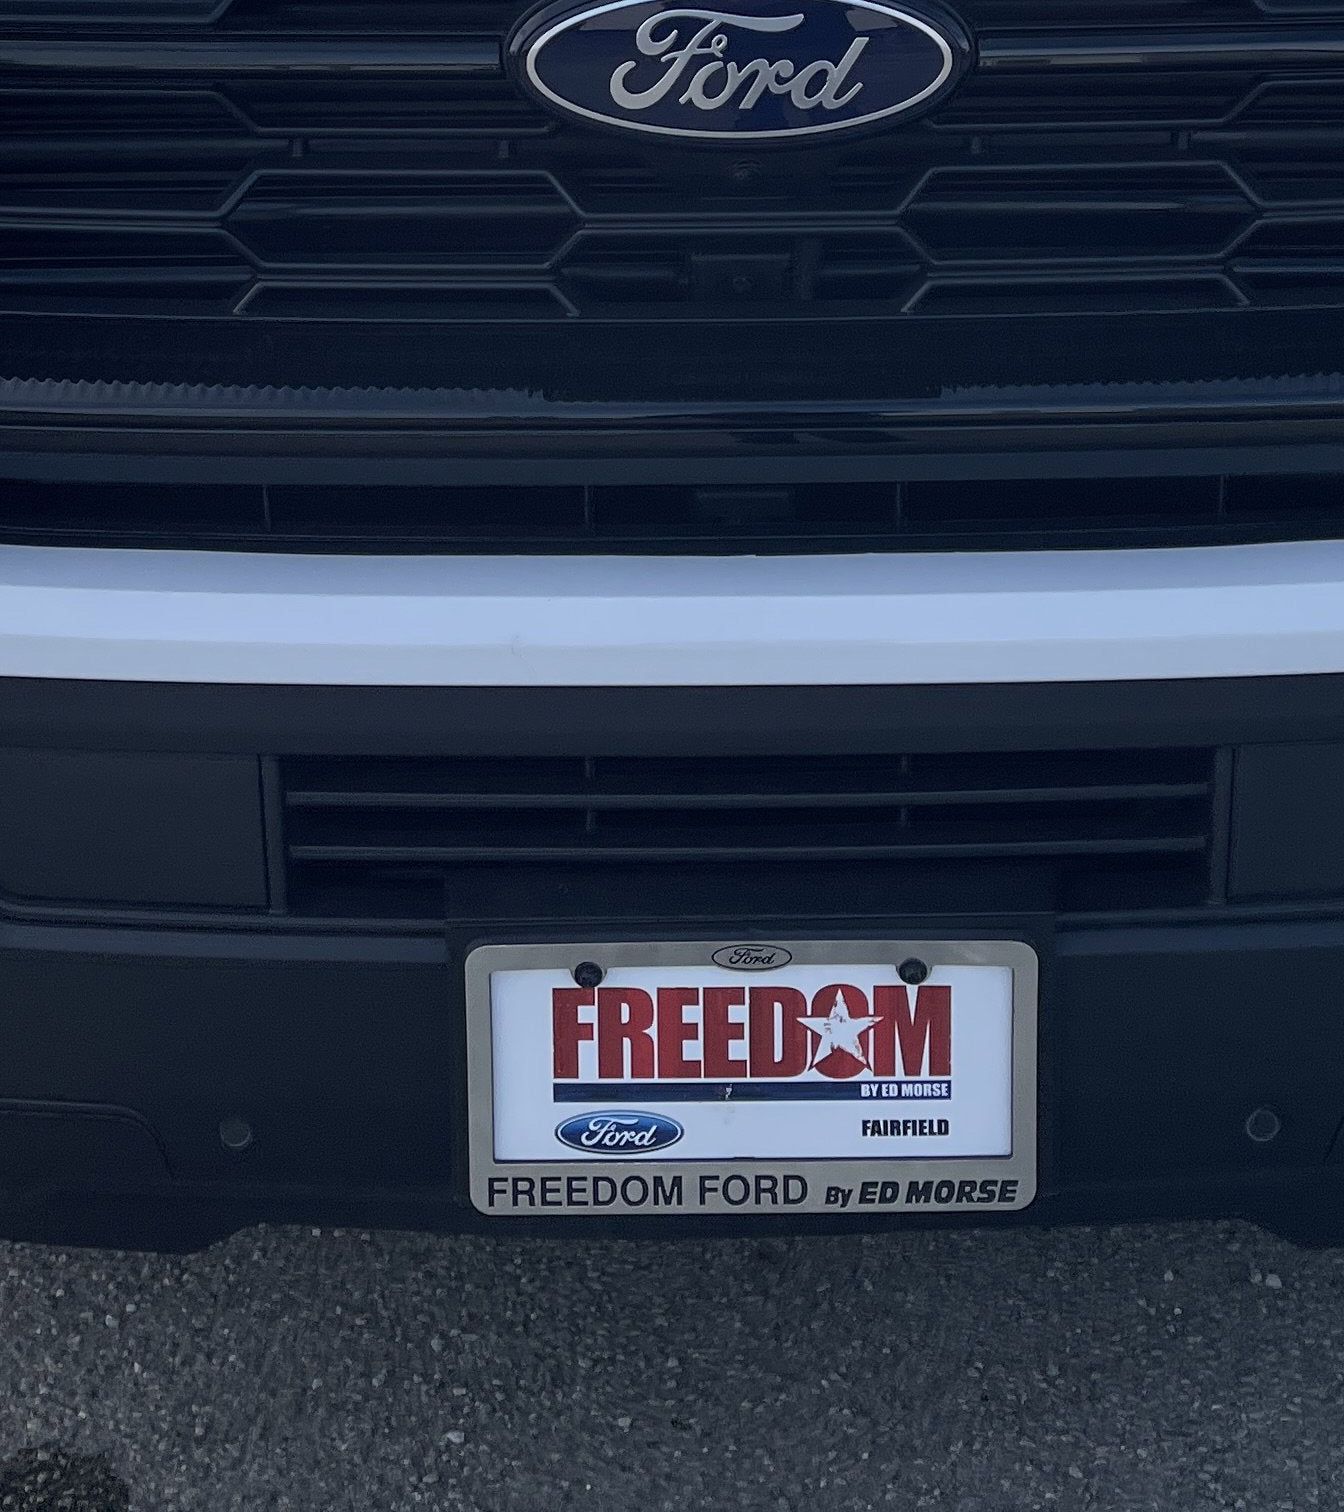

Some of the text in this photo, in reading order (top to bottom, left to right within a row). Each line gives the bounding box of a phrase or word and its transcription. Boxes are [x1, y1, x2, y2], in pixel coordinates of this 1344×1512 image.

[609, 8, 870, 110] Ford
[728, 947, 777, 964] Ford
[552, 983, 952, 1080] FREEDOM
[861, 1083, 949, 1097] BY ED MORSE
[581, 1116, 658, 1146] Ford
[862, 1119, 949, 1137] FAIRFIELD
[487, 1174, 1019, 1208] FREEDOM FORD By ED MORSE
